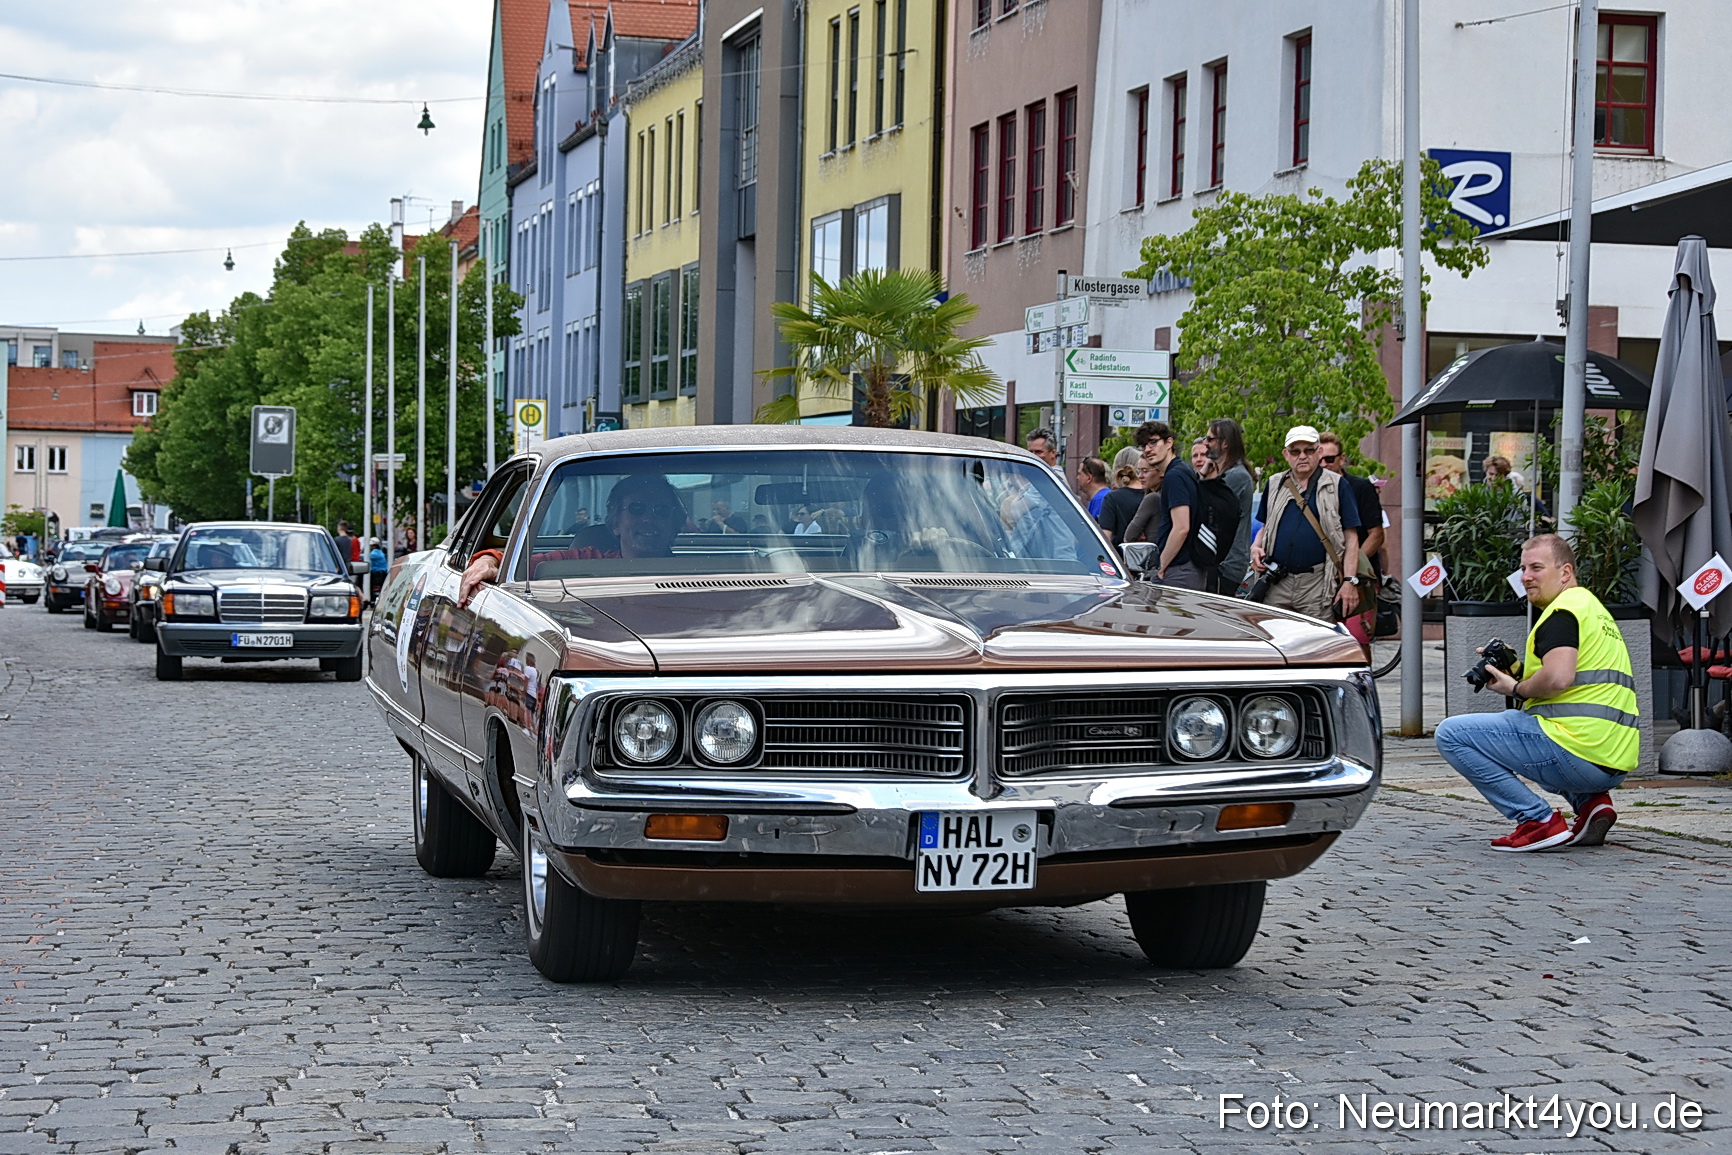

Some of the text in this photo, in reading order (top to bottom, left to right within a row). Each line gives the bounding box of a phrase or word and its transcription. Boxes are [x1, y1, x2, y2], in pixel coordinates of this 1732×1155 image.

[1074, 279, 1140, 296] Klostergasse
[1090, 353, 1117, 362] Radinfo
[1089, 362, 1131, 372] Ladestation
[1069, 381, 1087, 390] Kastl
[1069, 390, 1094, 399] Pilsach
[1695, 569, 1718, 590] CLASSIC
[1700, 575, 1720, 594] SPRINT
[943, 815, 1004, 849] HAL
[924, 834, 934, 845] D
[923, 851, 1030, 886] NY 72H
